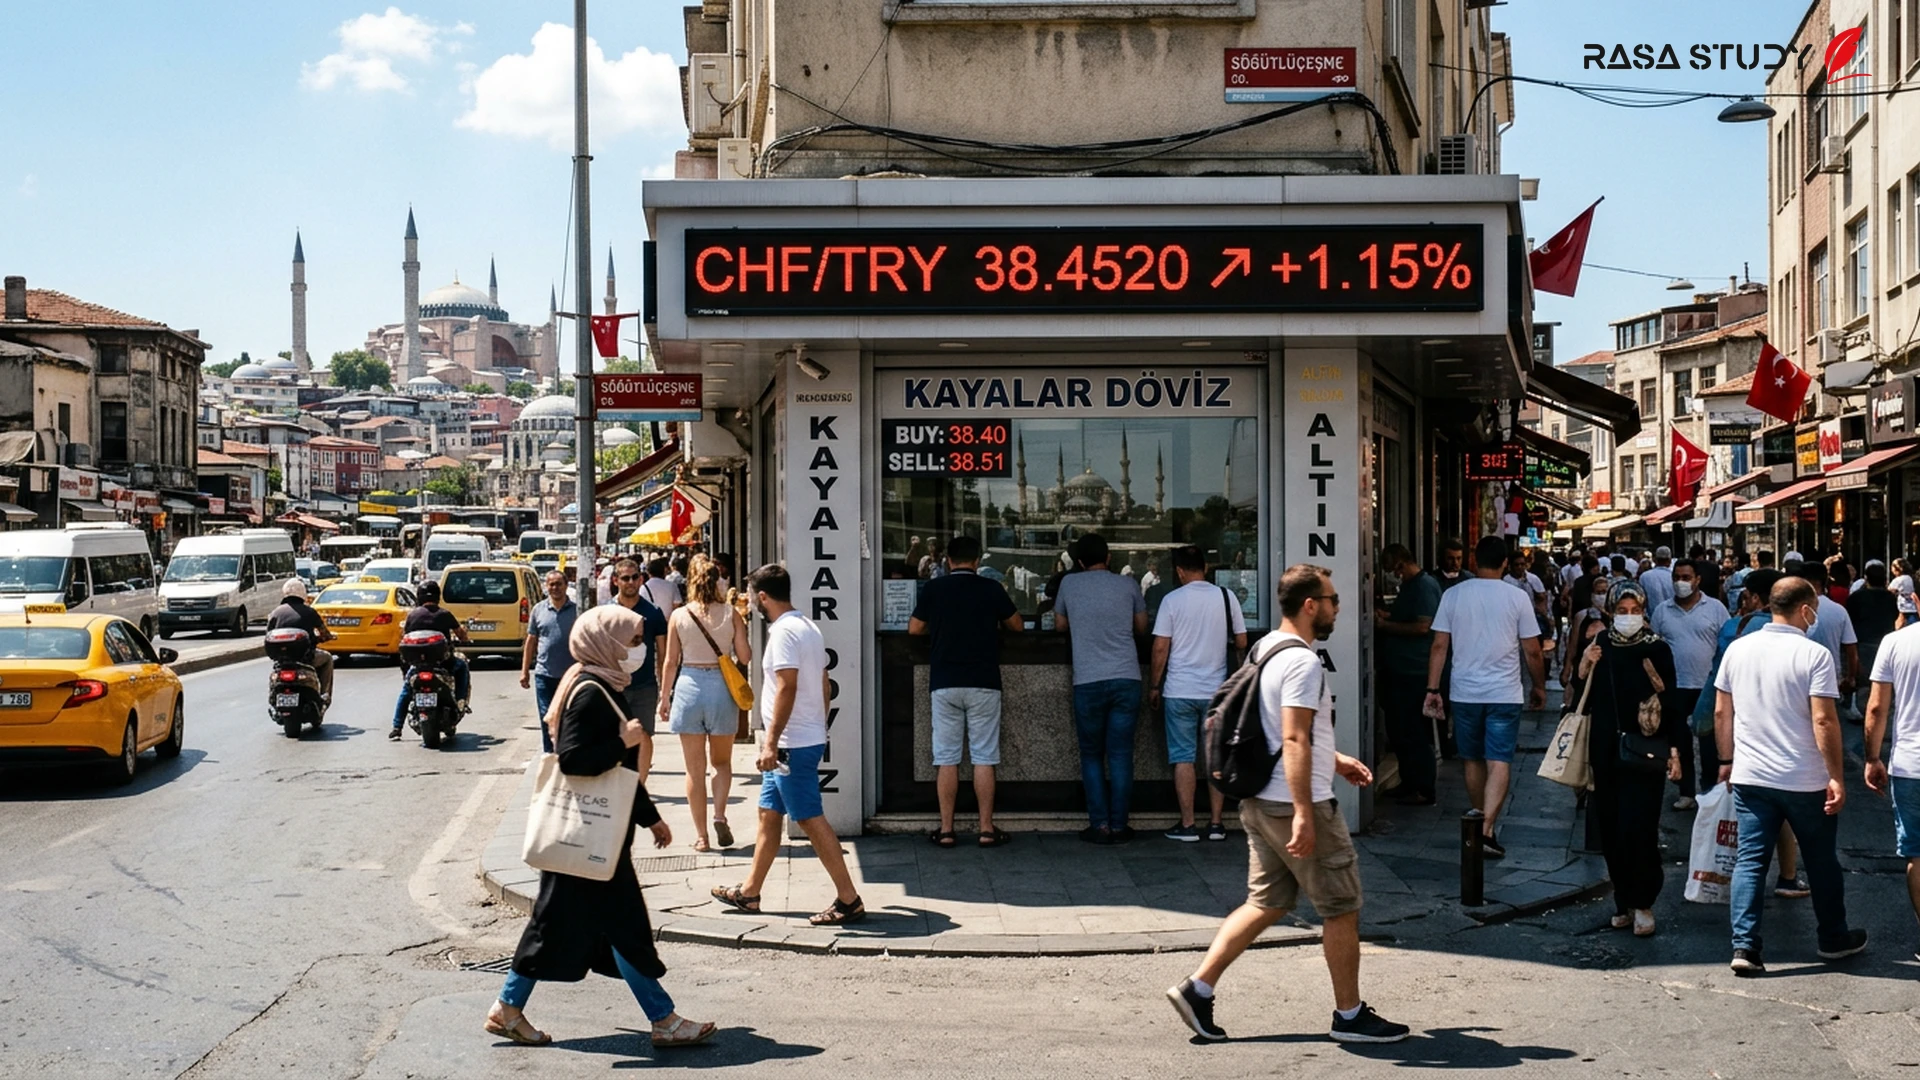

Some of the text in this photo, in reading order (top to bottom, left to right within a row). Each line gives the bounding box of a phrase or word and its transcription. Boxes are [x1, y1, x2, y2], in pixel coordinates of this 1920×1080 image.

[695, 243, 1472, 293] CHF/TRY 38.4520 +1.15%
[904, 370, 1232, 408] KAYALAR DÖVİZ
[896, 425, 1007, 445] BUY: 38.40
[888, 452, 1004, 472] SELL: 38.51
[1307, 412, 1336, 557] ALTIN
[809, 415, 840, 621] KAYALAR
